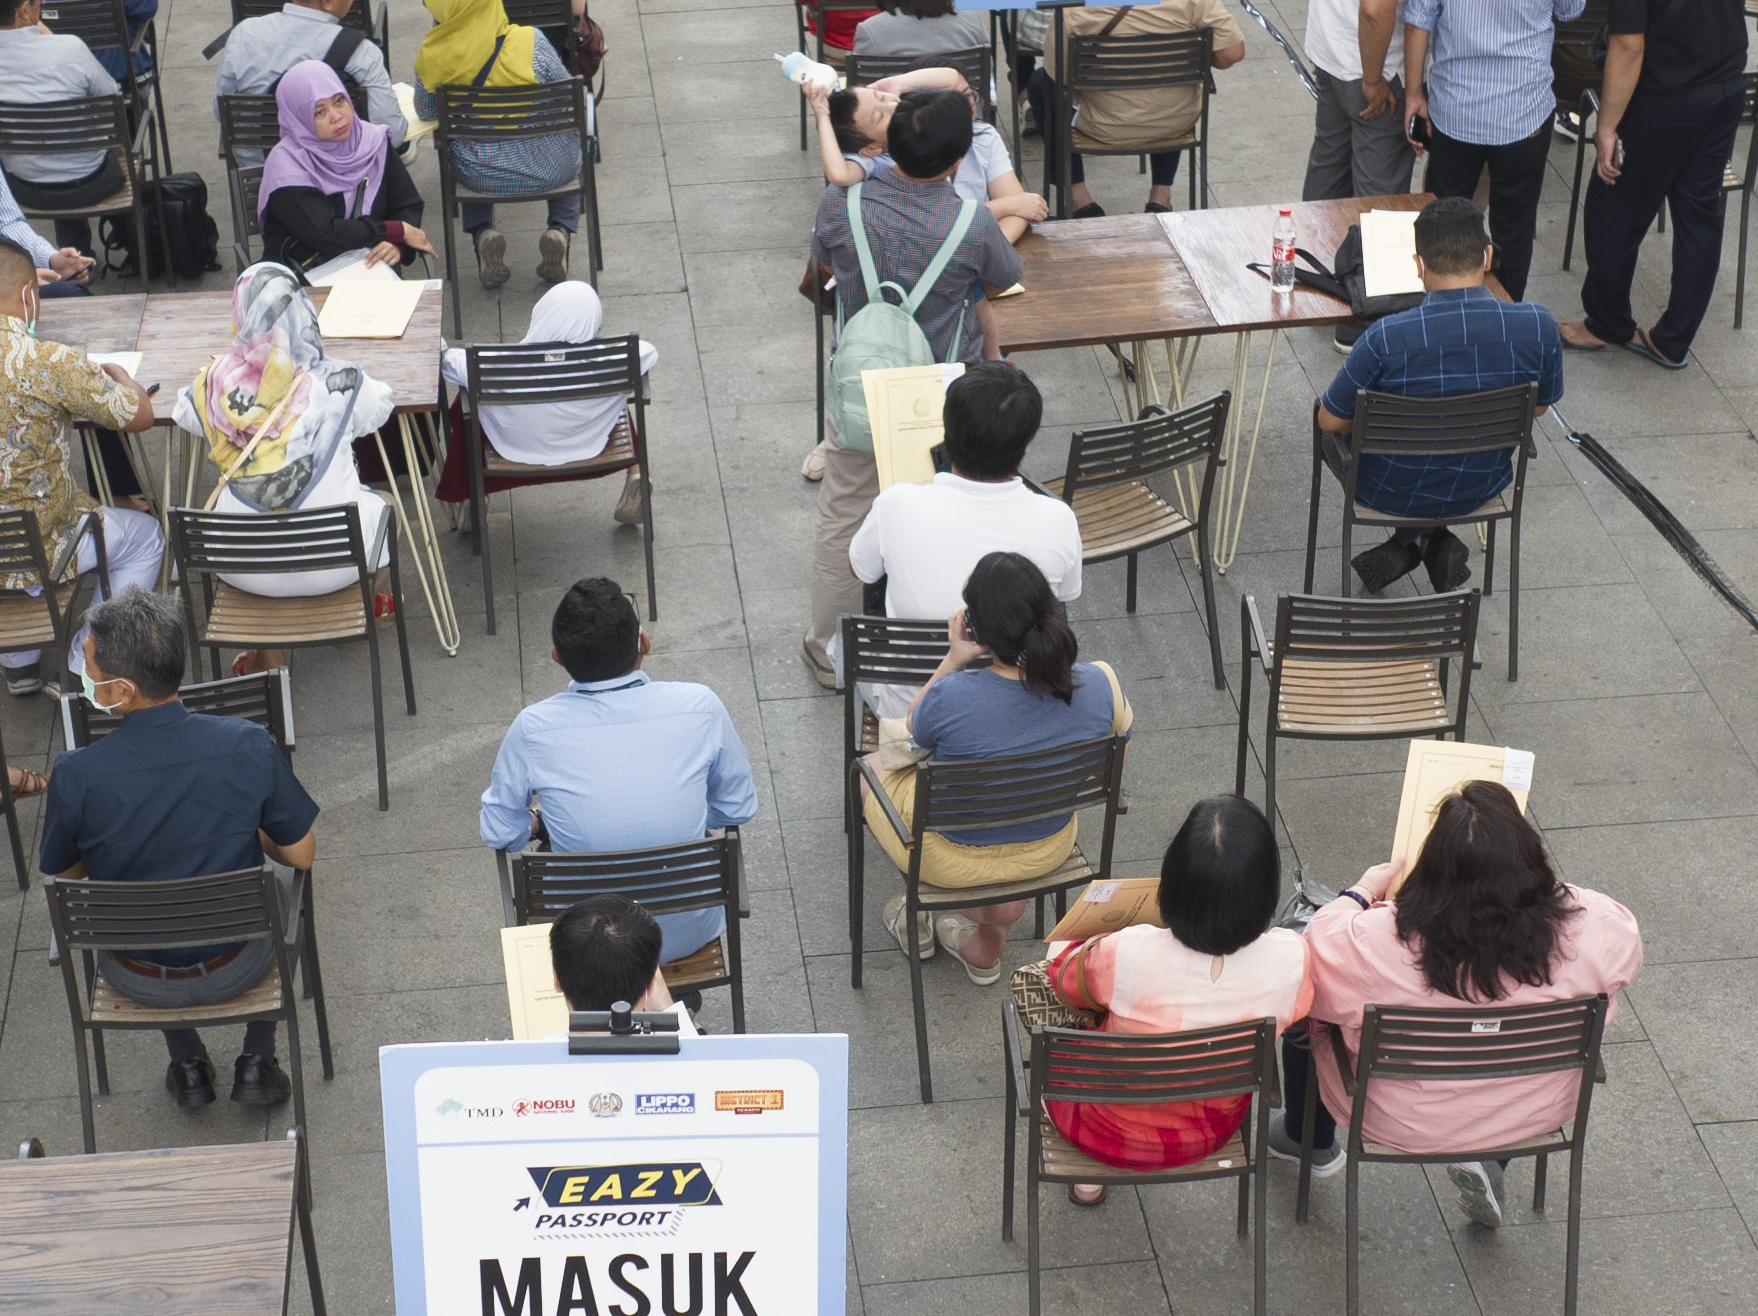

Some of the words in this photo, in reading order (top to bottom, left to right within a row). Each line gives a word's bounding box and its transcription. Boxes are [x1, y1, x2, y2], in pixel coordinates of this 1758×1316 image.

[533, 1099, 576, 1110] NOBU
[640, 1095, 690, 1107] LIPPO
[720, 1093, 767, 1106] DISTRICT
[463, 1107, 504, 1119] TMD
[636, 1106, 695, 1115] CIKARANG
[559, 1167, 703, 1205] EAZY
[534, 1210, 673, 1229] PASSPORT
